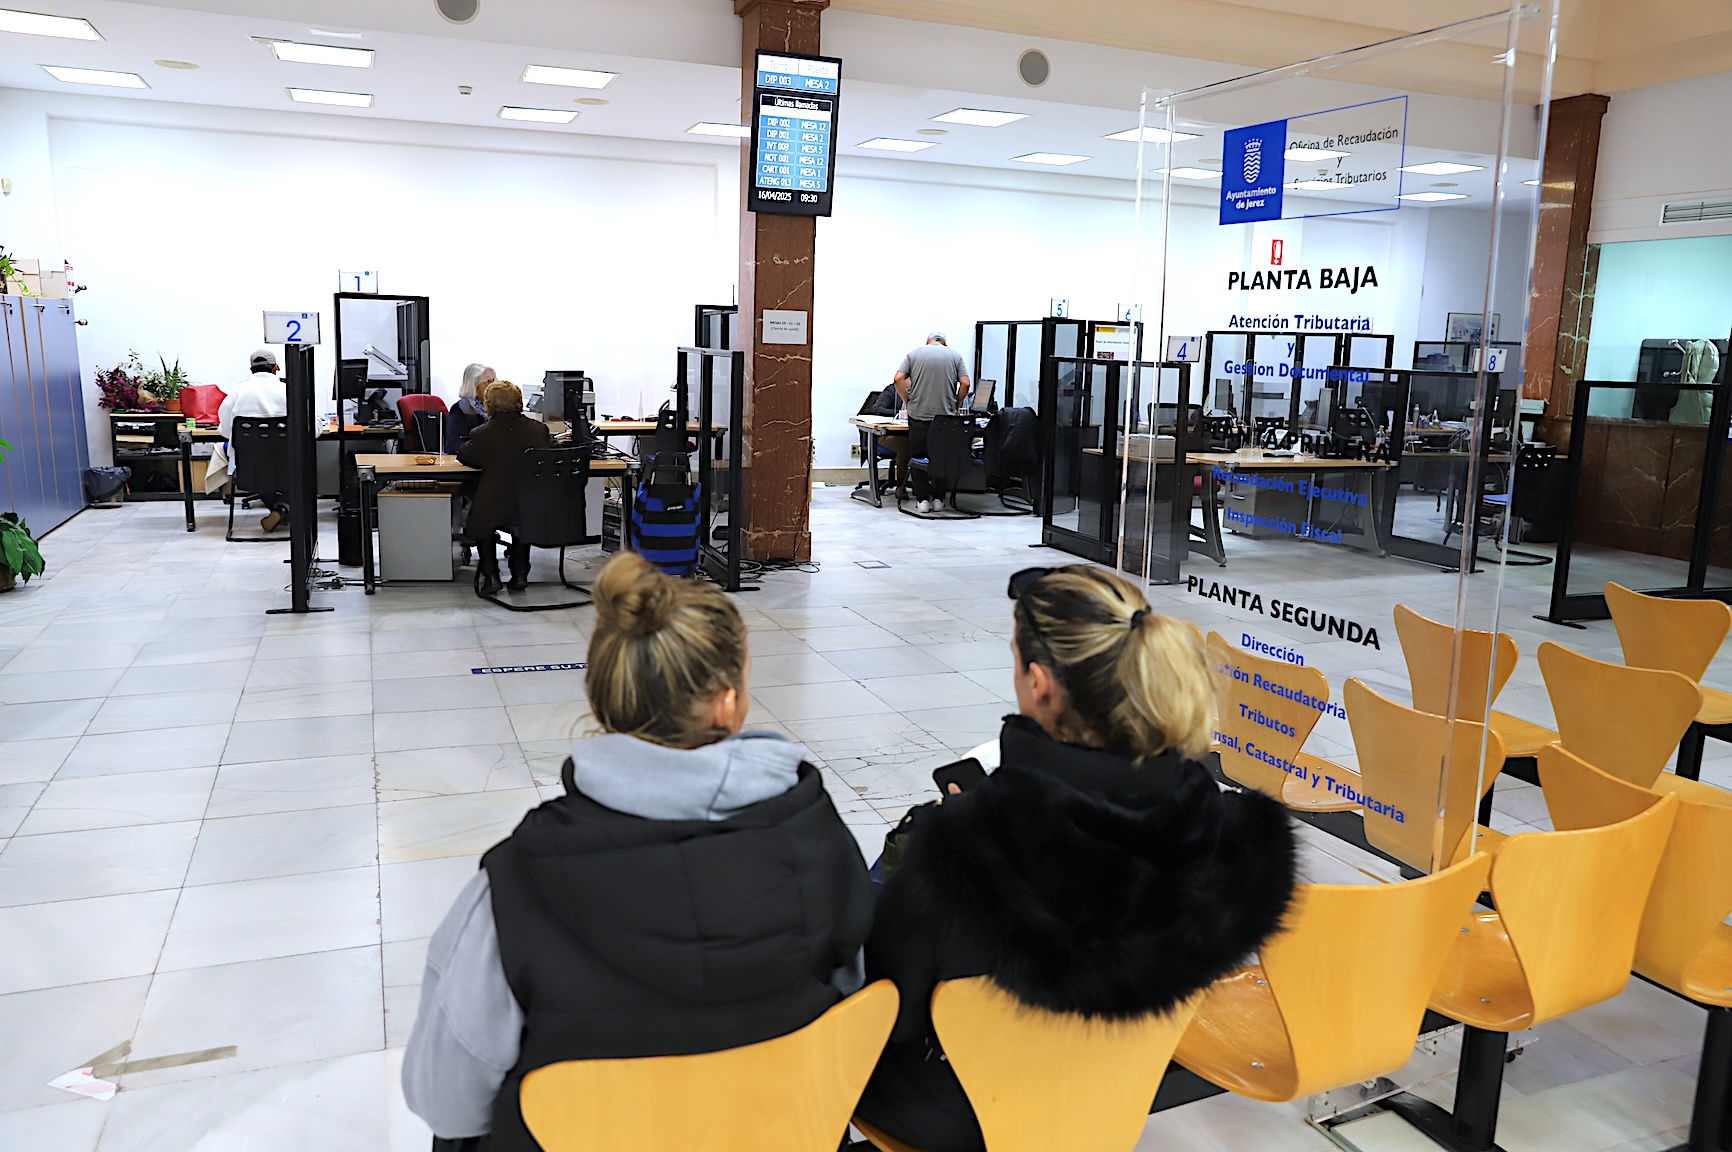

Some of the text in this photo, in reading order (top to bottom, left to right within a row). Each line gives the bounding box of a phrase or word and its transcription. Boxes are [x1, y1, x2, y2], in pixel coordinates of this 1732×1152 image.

[765, 74, 830, 90] DIP 003 MESA 2
[774, 96, 818, 110] Últimas llamadas
[768, 118, 826, 131] DIP 002 MESA 12
[766, 130, 824, 142] DIP 001 MESA 2
[1323, 137, 1334, 148] de
[1337, 127, 1398, 146] Recaudación
[778, 143, 789, 151] 009
[802, 145, 817, 153] MESA
[819, 146, 823, 154] 5
[764, 153, 777, 161] NOT
[799, 156, 815, 165] MESA
[816, 158, 824, 166] 12
[1337, 156, 1343, 168] y
[762, 165, 778, 174] CART
[779, 166, 790, 174] 001
[800, 168, 816, 177] MESA
[1335, 170, 1387, 184] Tributarios
[781, 178, 791, 186] 013
[800, 180, 815, 188] MESA
[758, 191, 818, 203] 16/04/2025 09:30
[1226, 186, 1276, 201] Ayuntamiento
[1236, 198, 1265, 210] de Jerez
[355, 276, 360, 292] 1
[1228, 266, 1378, 294] PLANTA BAJA
[1057, 303, 1062, 316] 5
[286, 320, 301, 341] 2
[1228, 314, 1370, 331] Atención Tributaria
[1177, 343, 1186, 360] 4
[1288, 342, 1295, 357] y
[1488, 355, 1496, 371] 8
[1278, 362, 1370, 384] Documental
[1212, 466, 1367, 506] Recaudación Ejecutiva
[1227, 507, 1342, 544] Inspección Fiscal
[1187, 574, 1380, 650] PLANTA SEGUNDA
[1241, 633, 1304, 666] Dirección
[481, 666, 546, 674] ESPERE
[1254, 673, 1346, 720] Recaudatoria
[1239, 703, 1296, 738] Tributos
[1245, 742, 1307, 780] Catastral
[1312, 772, 1320, 787] y
[1325, 775, 1405, 824] Tributaria
